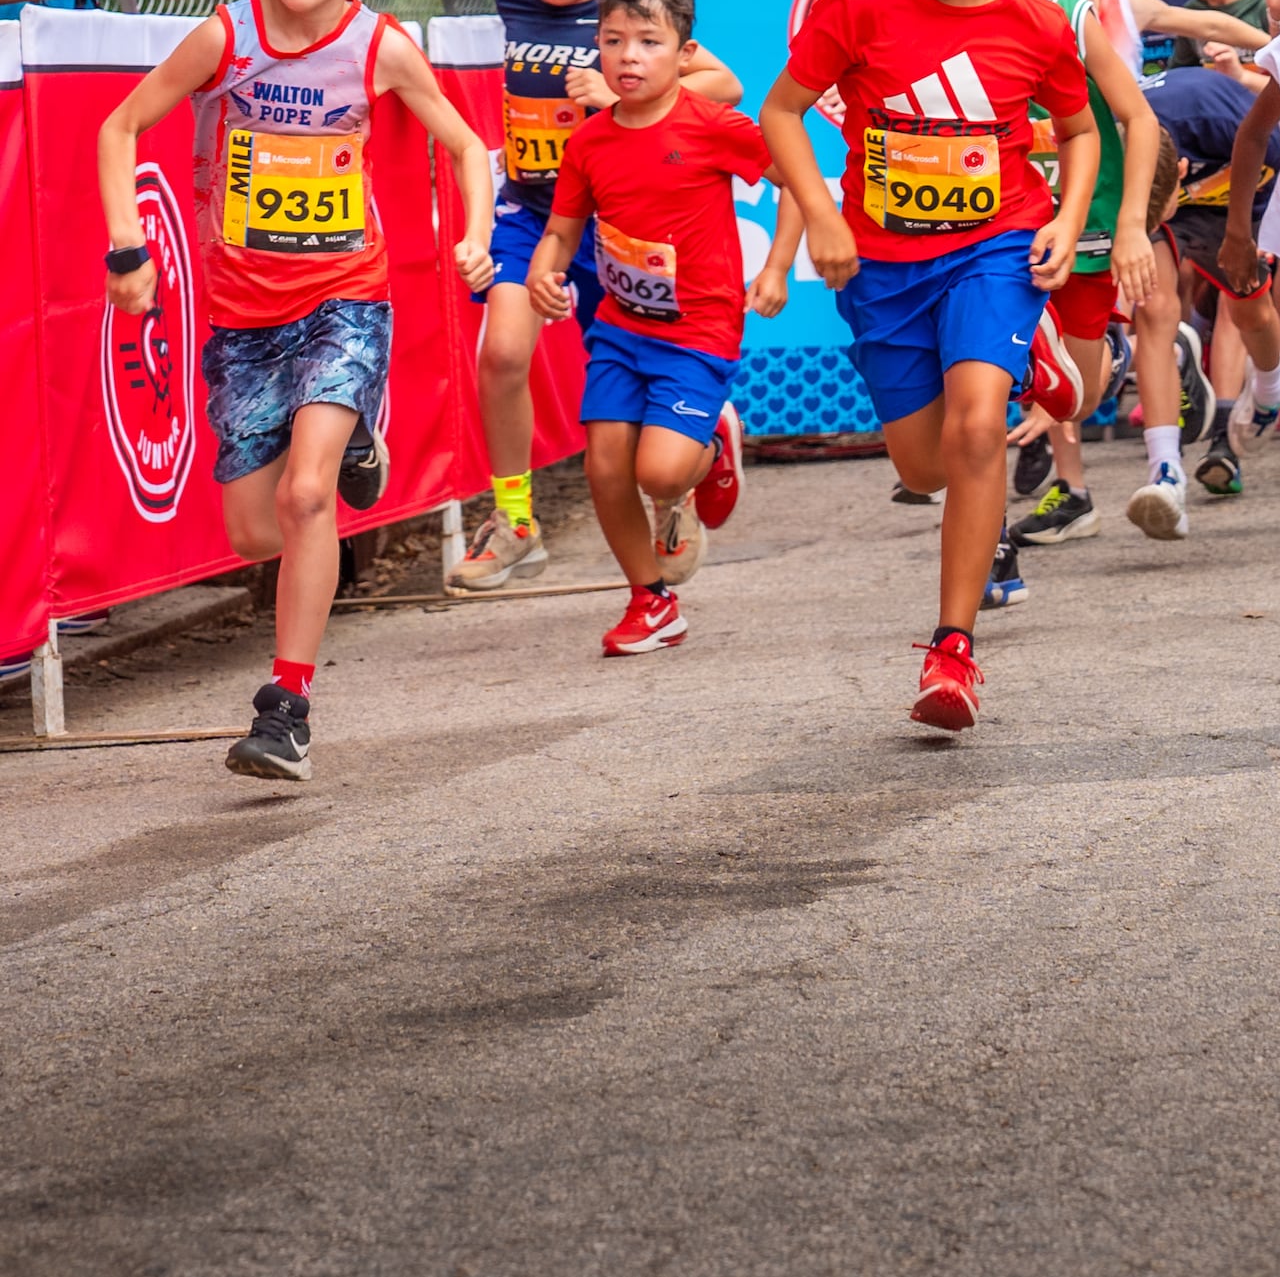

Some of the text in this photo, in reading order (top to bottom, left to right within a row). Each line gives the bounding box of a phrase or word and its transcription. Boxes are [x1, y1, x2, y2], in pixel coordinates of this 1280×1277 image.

[504, 41, 599, 67] MORY
[253, 81, 324, 106] WALTON
[259, 105, 312, 126] POPE
[230, 134, 253, 199] MILE
[272, 154, 313, 166] Microsoft
[867, 132, 886, 188] MILE
[903, 152, 940, 165] Microsoft
[256, 188, 350, 223] 9351
[890, 181, 995, 214] 9040
[606, 263, 675, 303] 6062
[137, 416, 181, 470] JUNIOR
